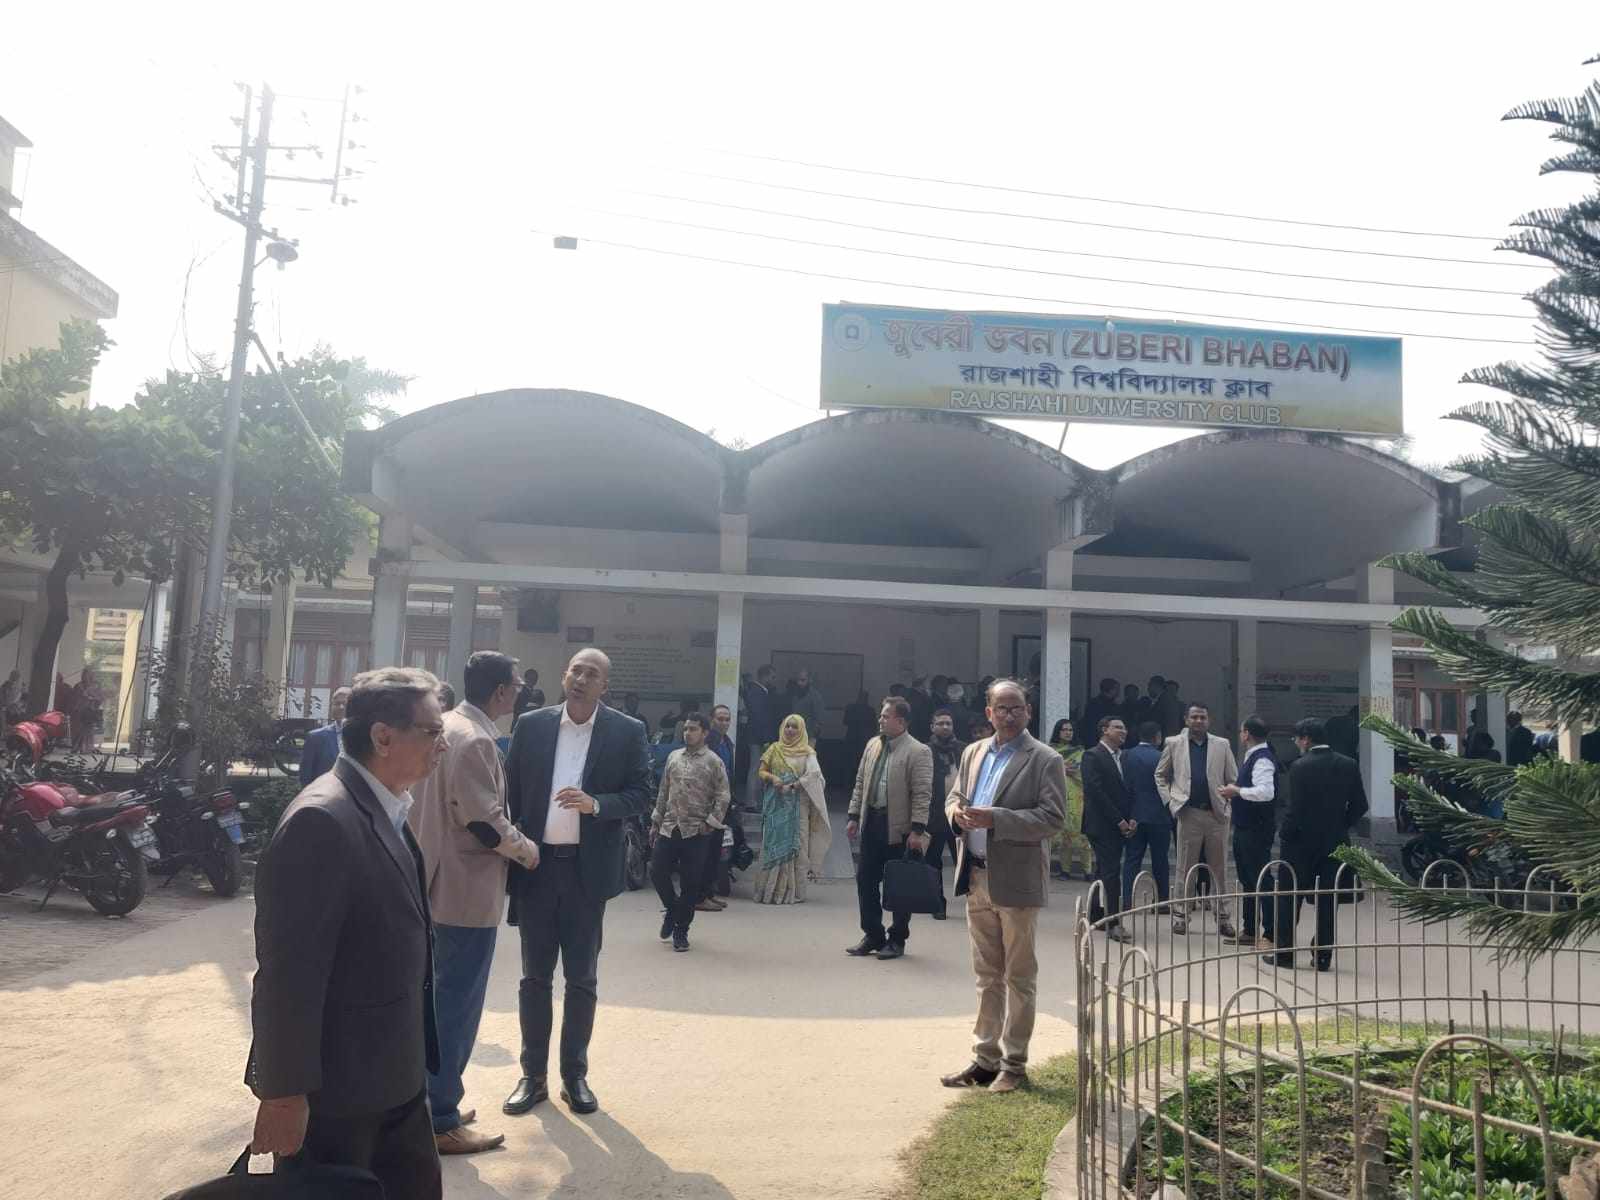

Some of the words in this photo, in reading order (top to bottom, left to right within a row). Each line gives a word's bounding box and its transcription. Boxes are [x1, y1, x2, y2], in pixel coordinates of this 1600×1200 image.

[983, 324, 1056, 356] ভবন
[1062, 328, 1192, 366] (ZUBERI
[1202, 335, 1350, 382] BHABAN)
[958, 362, 1062, 390] রাজশাহী
[1223, 377, 1274, 399] ক্লাব
[949, 389, 1068, 415] RAJSHAHI
[1073, 394, 1213, 422] UNIVERSITY
[1218, 402, 1282, 425] CLUB
